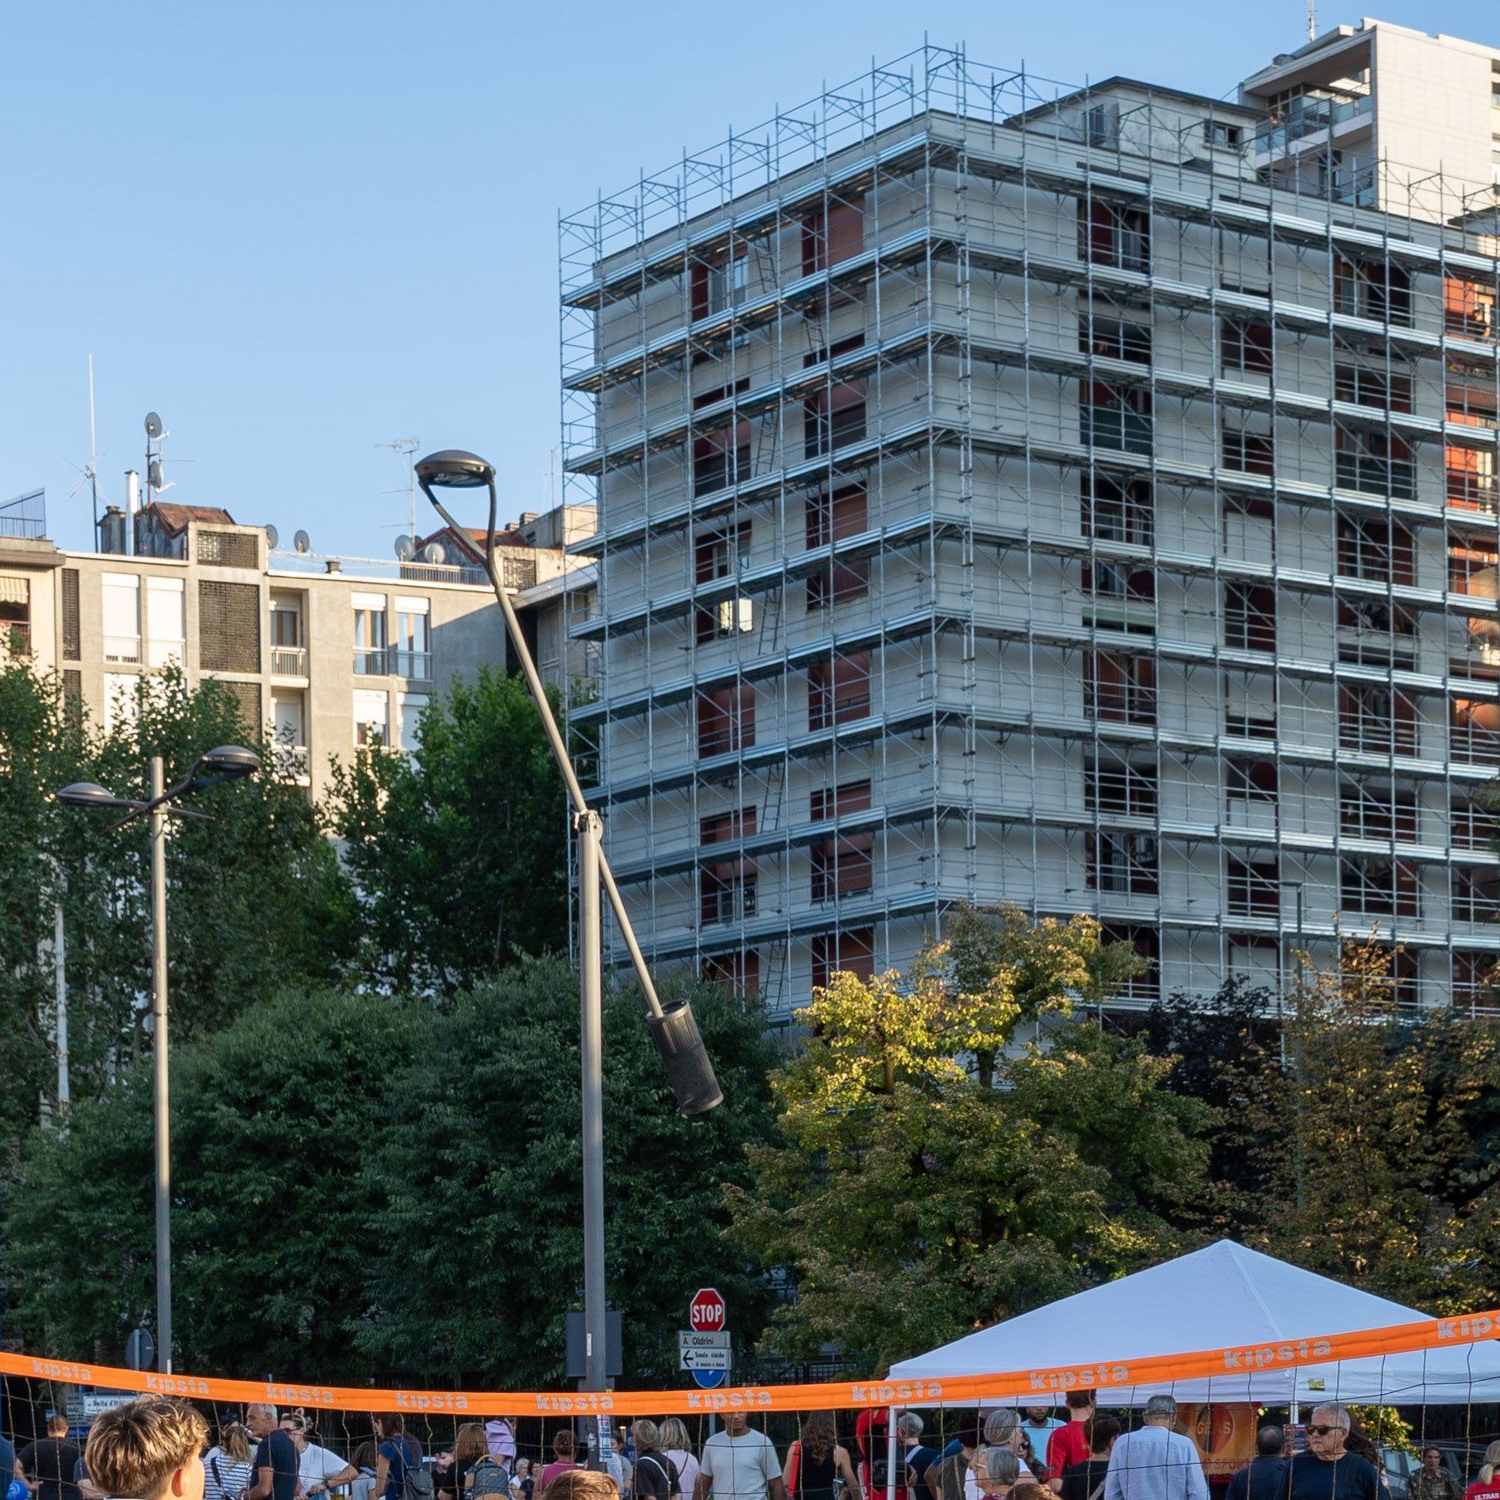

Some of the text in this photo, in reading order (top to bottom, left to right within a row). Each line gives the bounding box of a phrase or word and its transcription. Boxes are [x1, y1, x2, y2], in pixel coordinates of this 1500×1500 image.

[693, 1304, 722, 1323] STOP
[1223, 1339, 1332, 1370] kipsta
[32, 1359, 92, 1381] kipsta
[1029, 1363, 1129, 1391] kipsta
[146, 1375, 210, 1395] kipsta
[266, 1384, 335, 1404] kipsta
[852, 1380, 944, 1404] kipsta
[396, 1393, 469, 1411] kipsta
[536, 1394, 614, 1413] kipsta
[687, 1389, 772, 1410] kipsta
